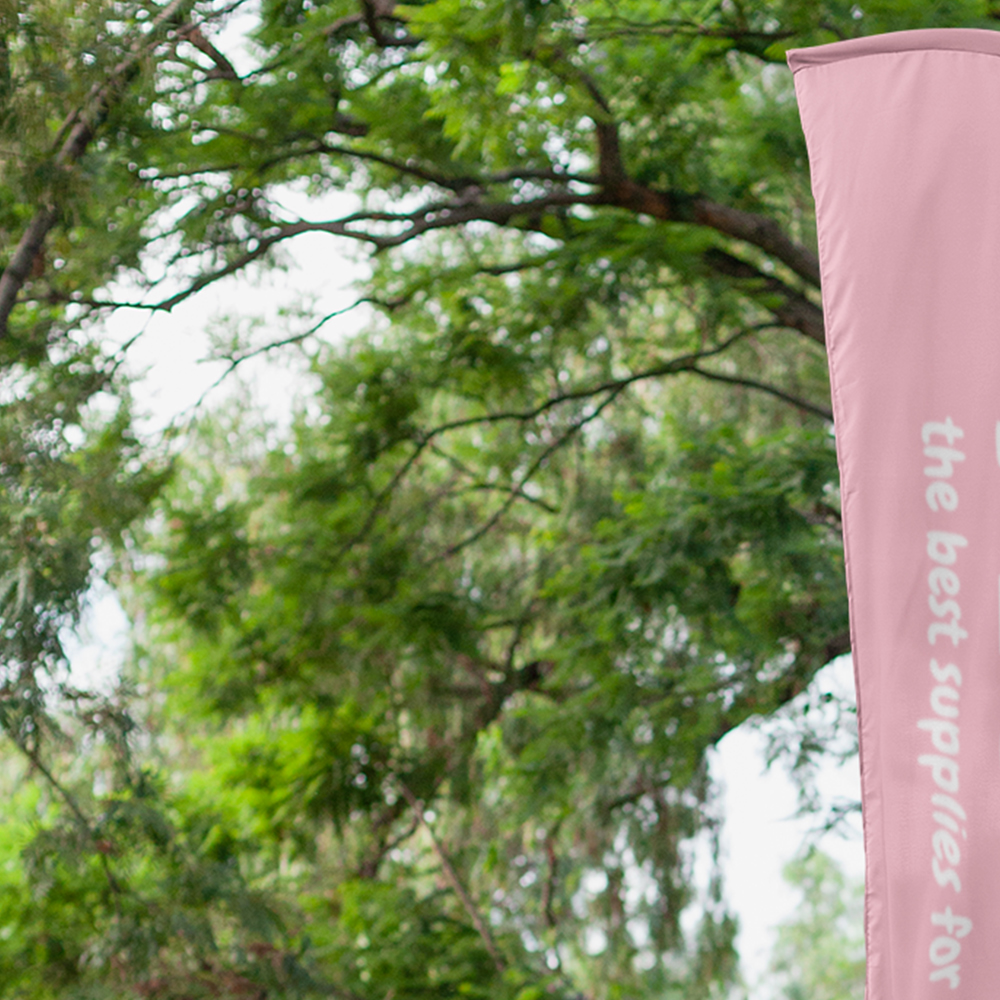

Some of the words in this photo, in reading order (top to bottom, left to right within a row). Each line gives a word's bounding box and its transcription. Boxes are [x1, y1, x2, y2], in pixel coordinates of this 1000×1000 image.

[921, 416, 966, 512] the
[926, 530, 968, 647] best
[916, 658, 967, 893] supplies
[929, 906, 972, 989] for
